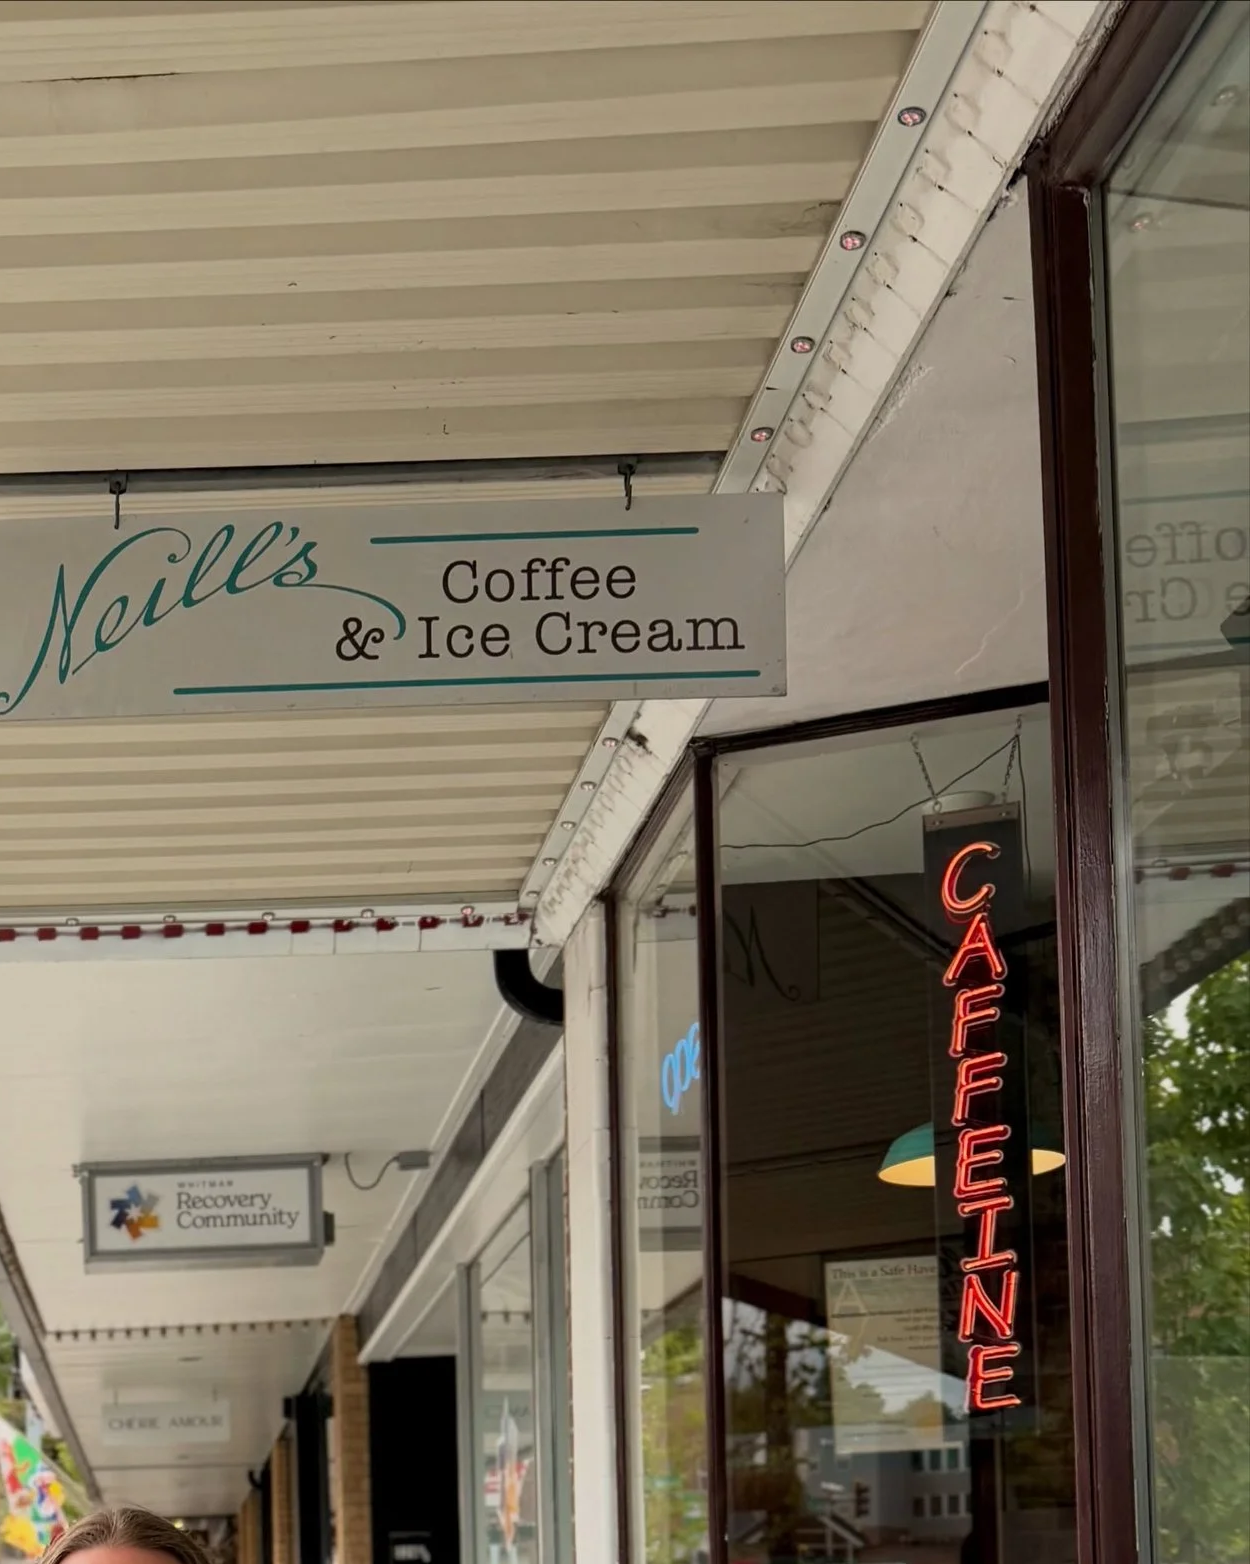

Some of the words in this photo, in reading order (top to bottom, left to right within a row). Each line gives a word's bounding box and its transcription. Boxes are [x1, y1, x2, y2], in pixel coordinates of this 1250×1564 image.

[441, 557, 637, 604] Coffee
[335, 615, 380, 662] &
[417, 615, 511, 661] Ice
[535, 611, 745, 658] Cream
[940, 841, 1021, 1413] CAFFEINE
[176, 1179, 234, 1190] WHITMAN
[176, 1191, 272, 1211] Recovery
[176, 1207, 300, 1230] Community
[832, 1267, 856, 1280] This
[860, 1267, 869, 1279] is
[871, 1270, 877, 1278] a
[880, 1264, 904, 1277] Safe
[908, 1263, 937, 1275] Have
